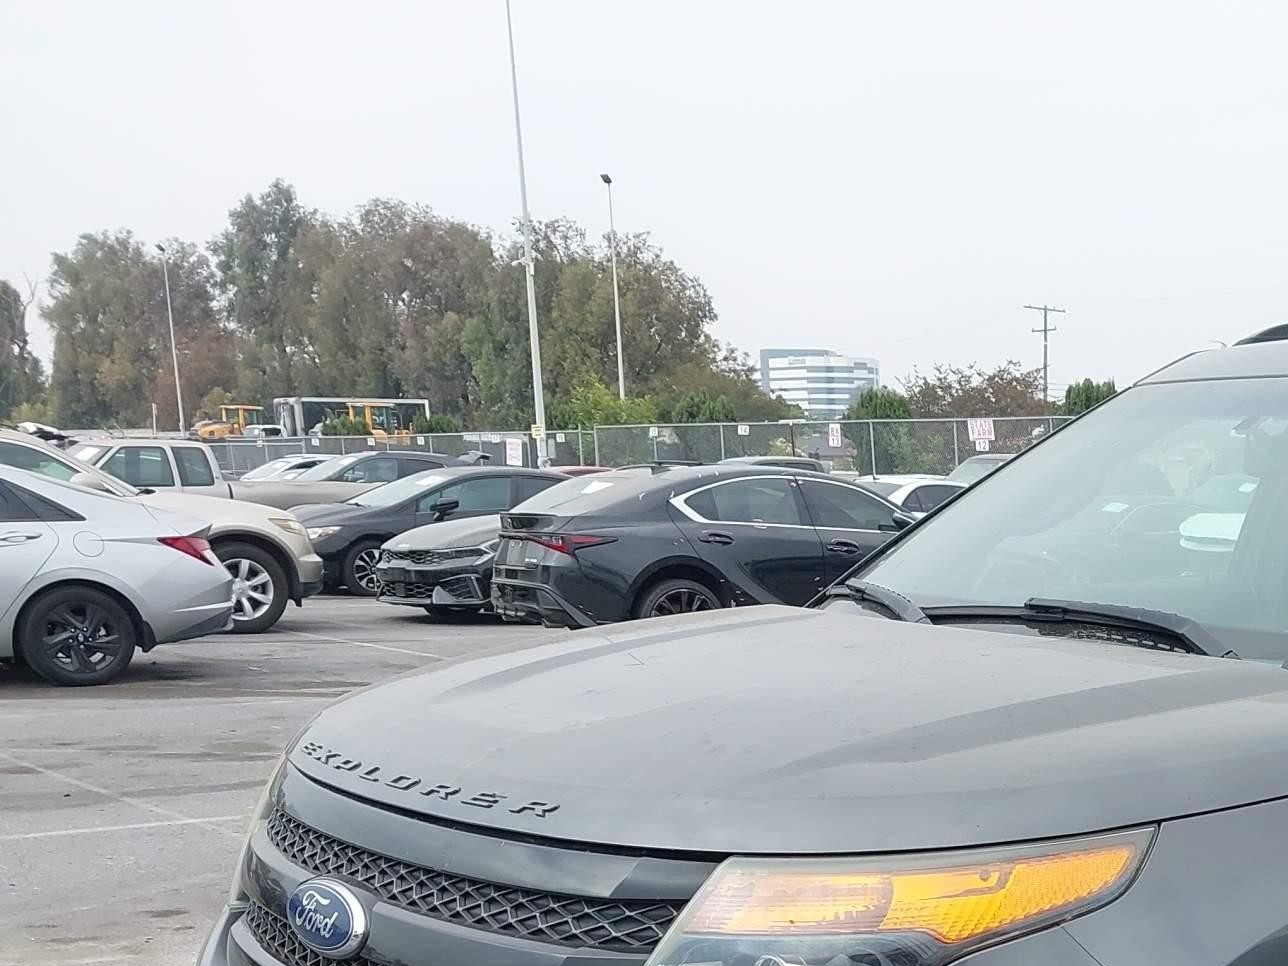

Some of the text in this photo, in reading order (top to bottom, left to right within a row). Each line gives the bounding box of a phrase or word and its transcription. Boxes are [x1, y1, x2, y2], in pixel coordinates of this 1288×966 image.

[977, 441, 987, 450] 12
[301, 741, 561, 818] EXPLORER
[295, 890, 338, 938] Ford
